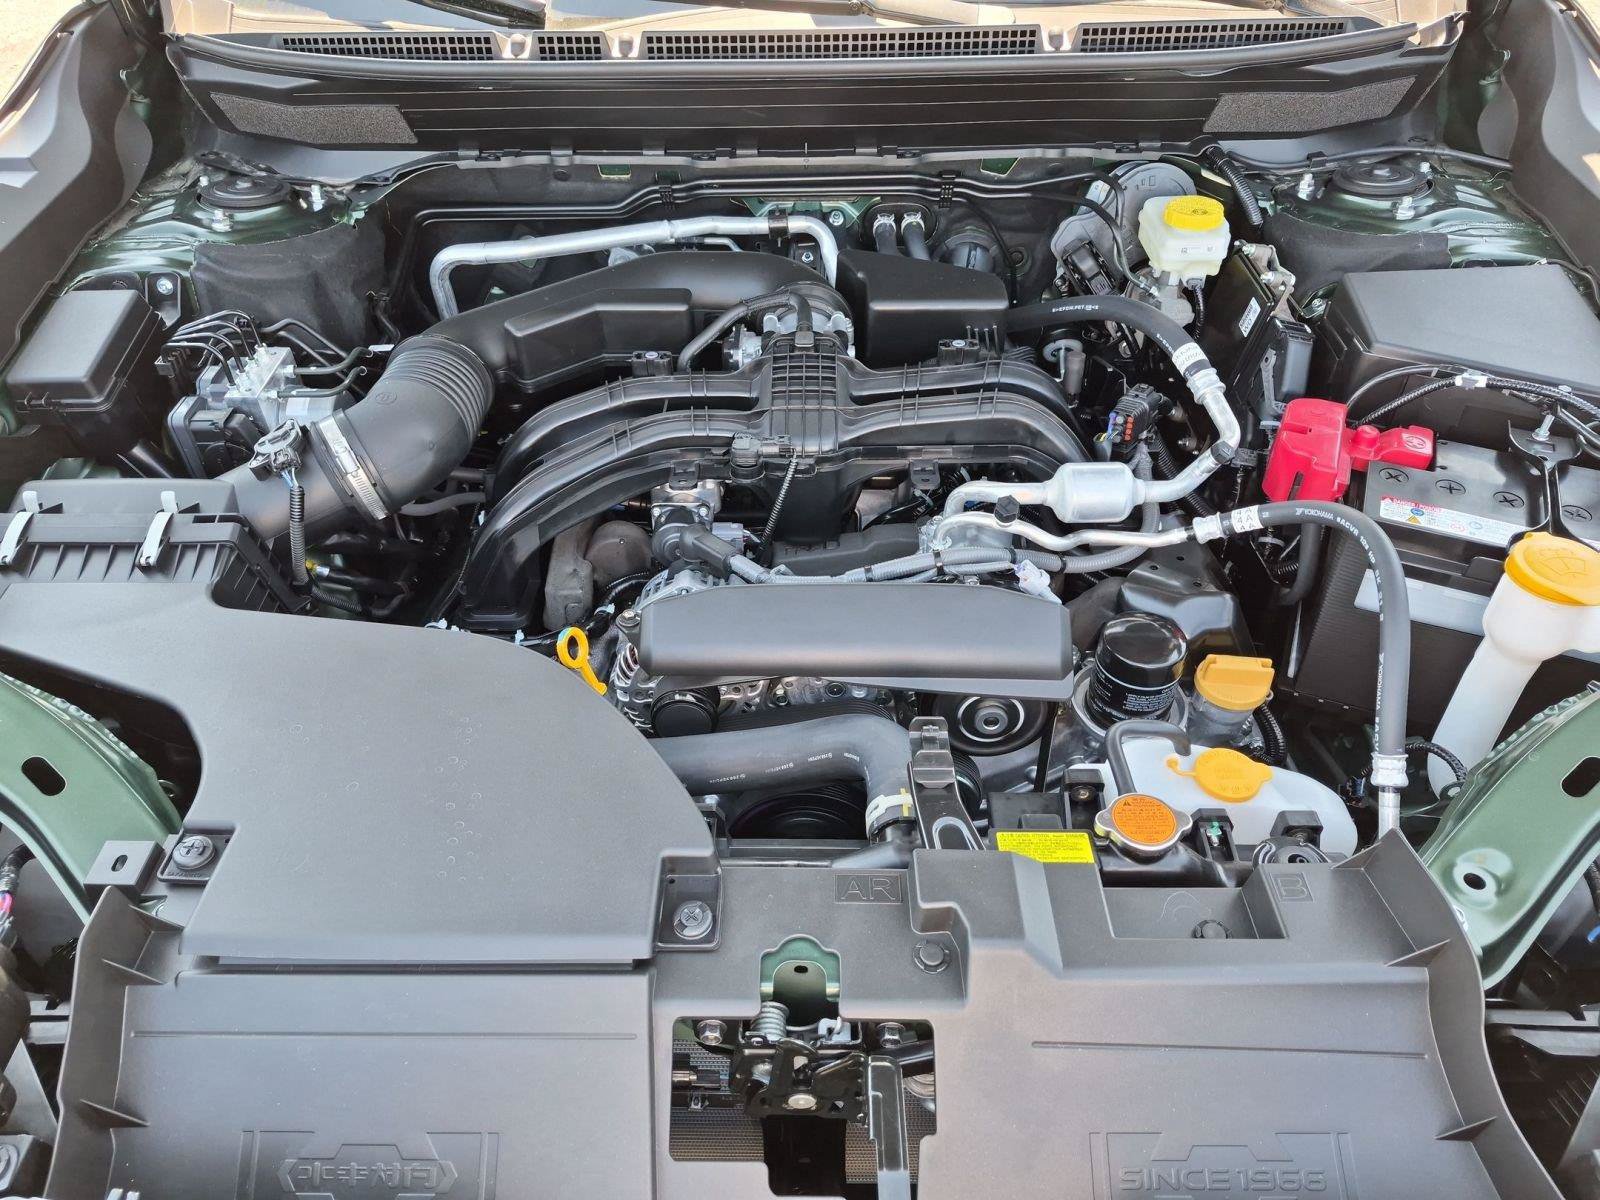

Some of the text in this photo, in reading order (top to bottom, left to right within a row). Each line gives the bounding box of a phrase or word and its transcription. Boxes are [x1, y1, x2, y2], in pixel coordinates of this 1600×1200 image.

[1303, 509, 1335, 520] YOKOHAMA
[840, 875, 897, 900] AR
[1119, 1167, 1231, 1192] SINCE
